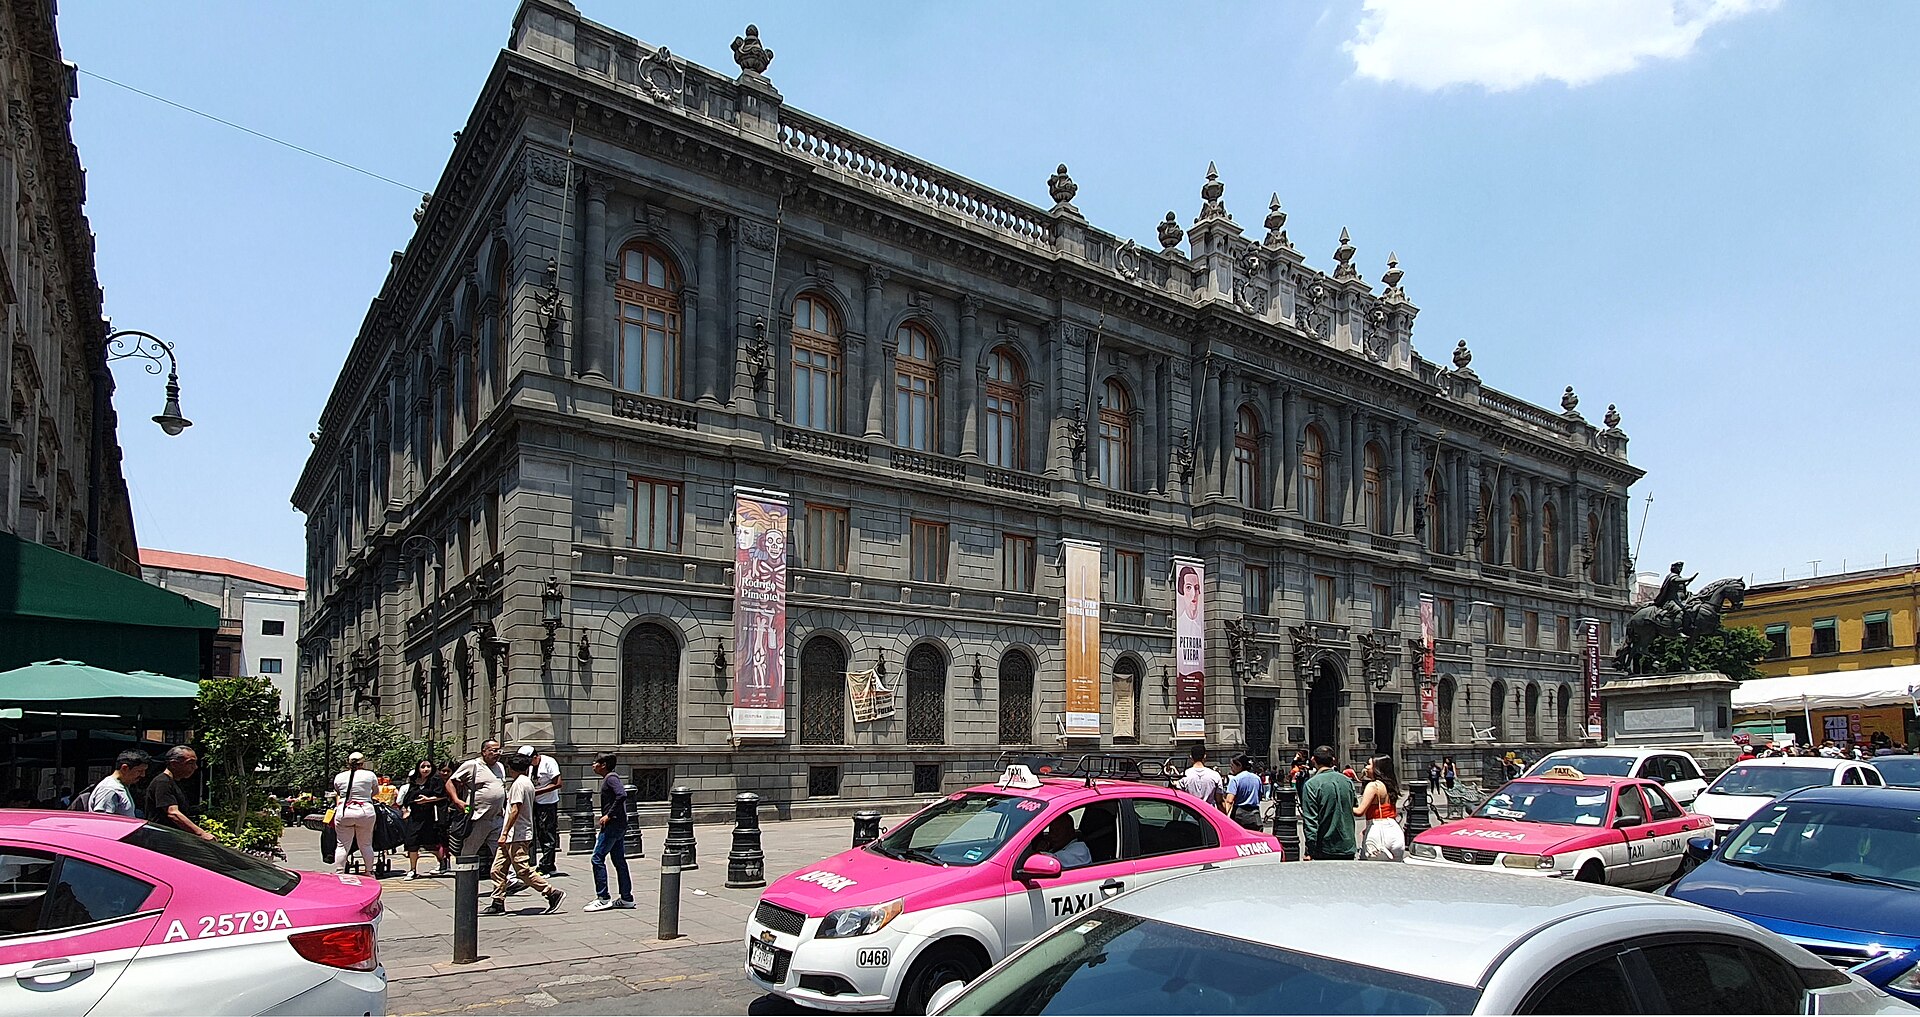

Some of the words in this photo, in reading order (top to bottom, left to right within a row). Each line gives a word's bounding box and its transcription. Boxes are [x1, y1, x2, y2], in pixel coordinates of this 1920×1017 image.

[742, 577, 776, 592] Rodrigo
[741, 589, 780, 602] Pimentel
[1179, 636, 1202, 649] PETRONA
[1183, 649, 1199, 660] VIERA
[1235, 841, 1273, 857] A9746K
[1628, 844, 1645, 859] TAXI
[1661, 838, 1681, 853] CDMX
[795, 870, 858, 893] A9746K
[1051, 892, 1093, 917] TAXI
[163, 919, 190, 942] A
[198, 908, 293, 938] 2579A
[859, 950, 888, 966] 0468
